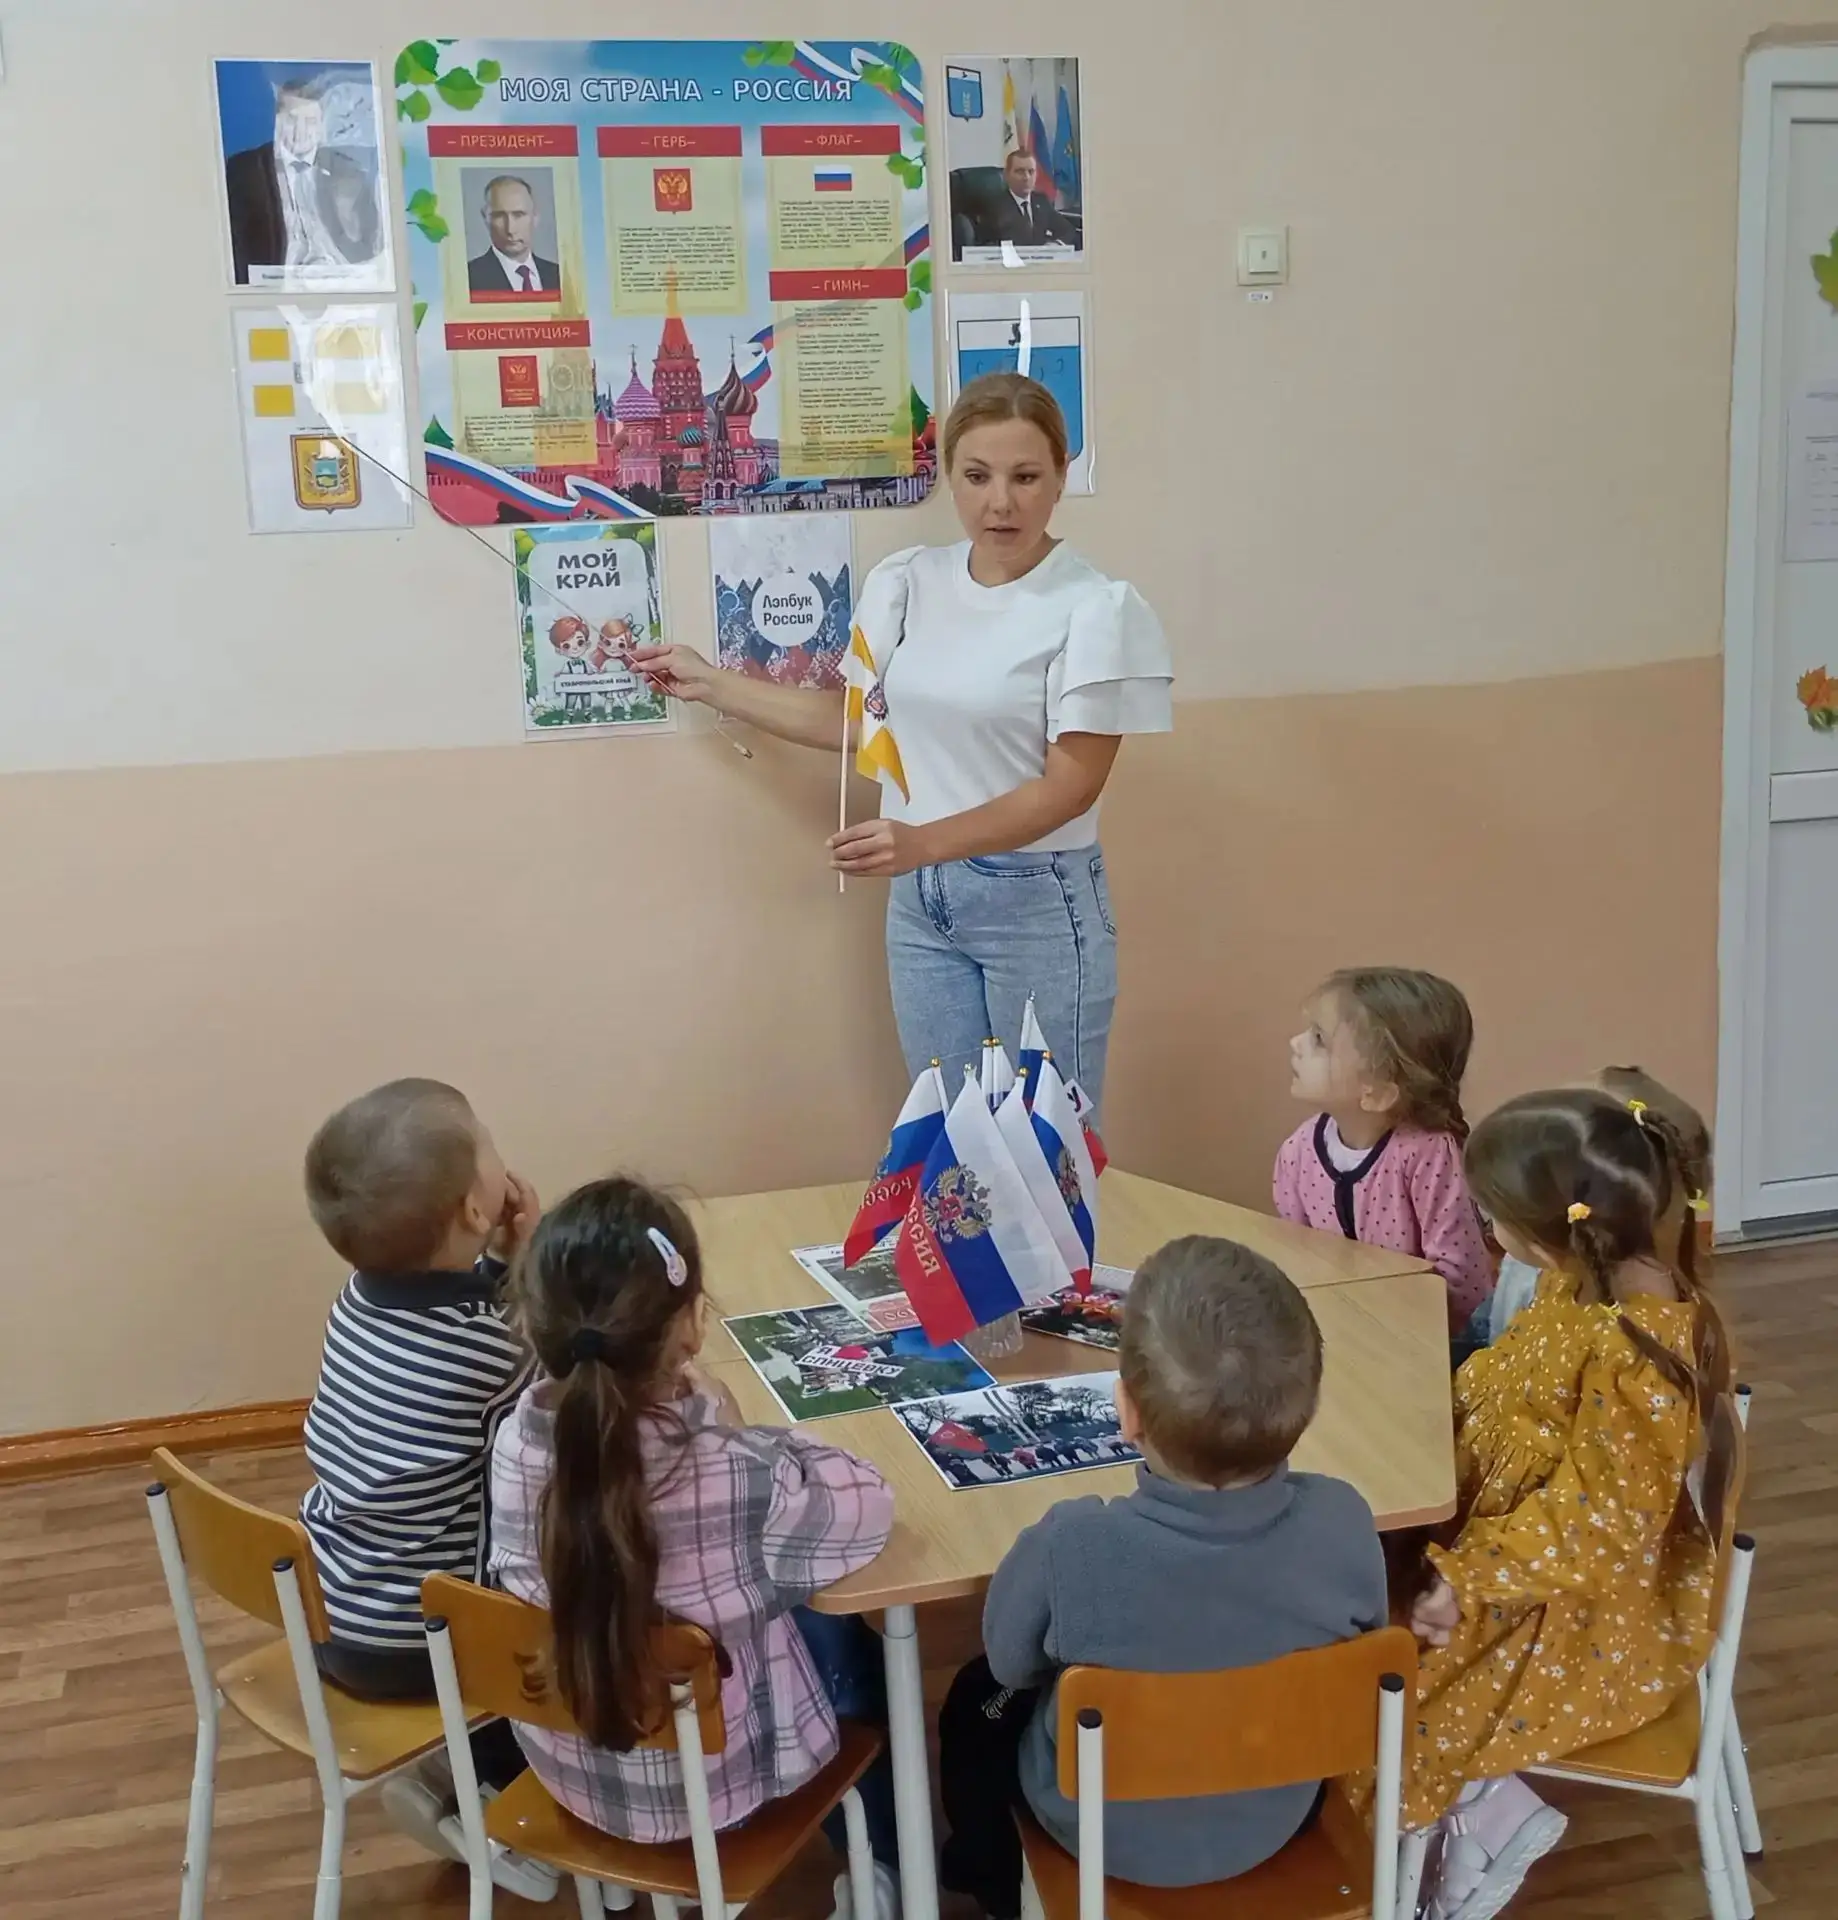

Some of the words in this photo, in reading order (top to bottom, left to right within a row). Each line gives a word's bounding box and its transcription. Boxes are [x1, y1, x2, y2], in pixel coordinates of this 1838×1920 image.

[500, 77, 571, 102] МОЯ
[581, 77, 703, 102] СТРАНА
[732, 77, 853, 102] РОССИЯ
[460, 134, 545, 149] ПРЕЗИДЕНТ
[653, 135, 688, 148] ГЕРБ
[816, 133, 854, 147] ФЛАГ
[823, 280, 862, 293] ГИМН
[467, 326, 571, 342] КОНСТИТУЦИЯ
[557, 549, 618, 570] МОЙ
[556, 569, 621, 590] КРАЙ
[762, 593, 813, 610] Лэпбук
[763, 611, 814, 626] Россия
[906, 1194, 941, 1278] ССИЯ
[817, 1346, 833, 1355] Я
